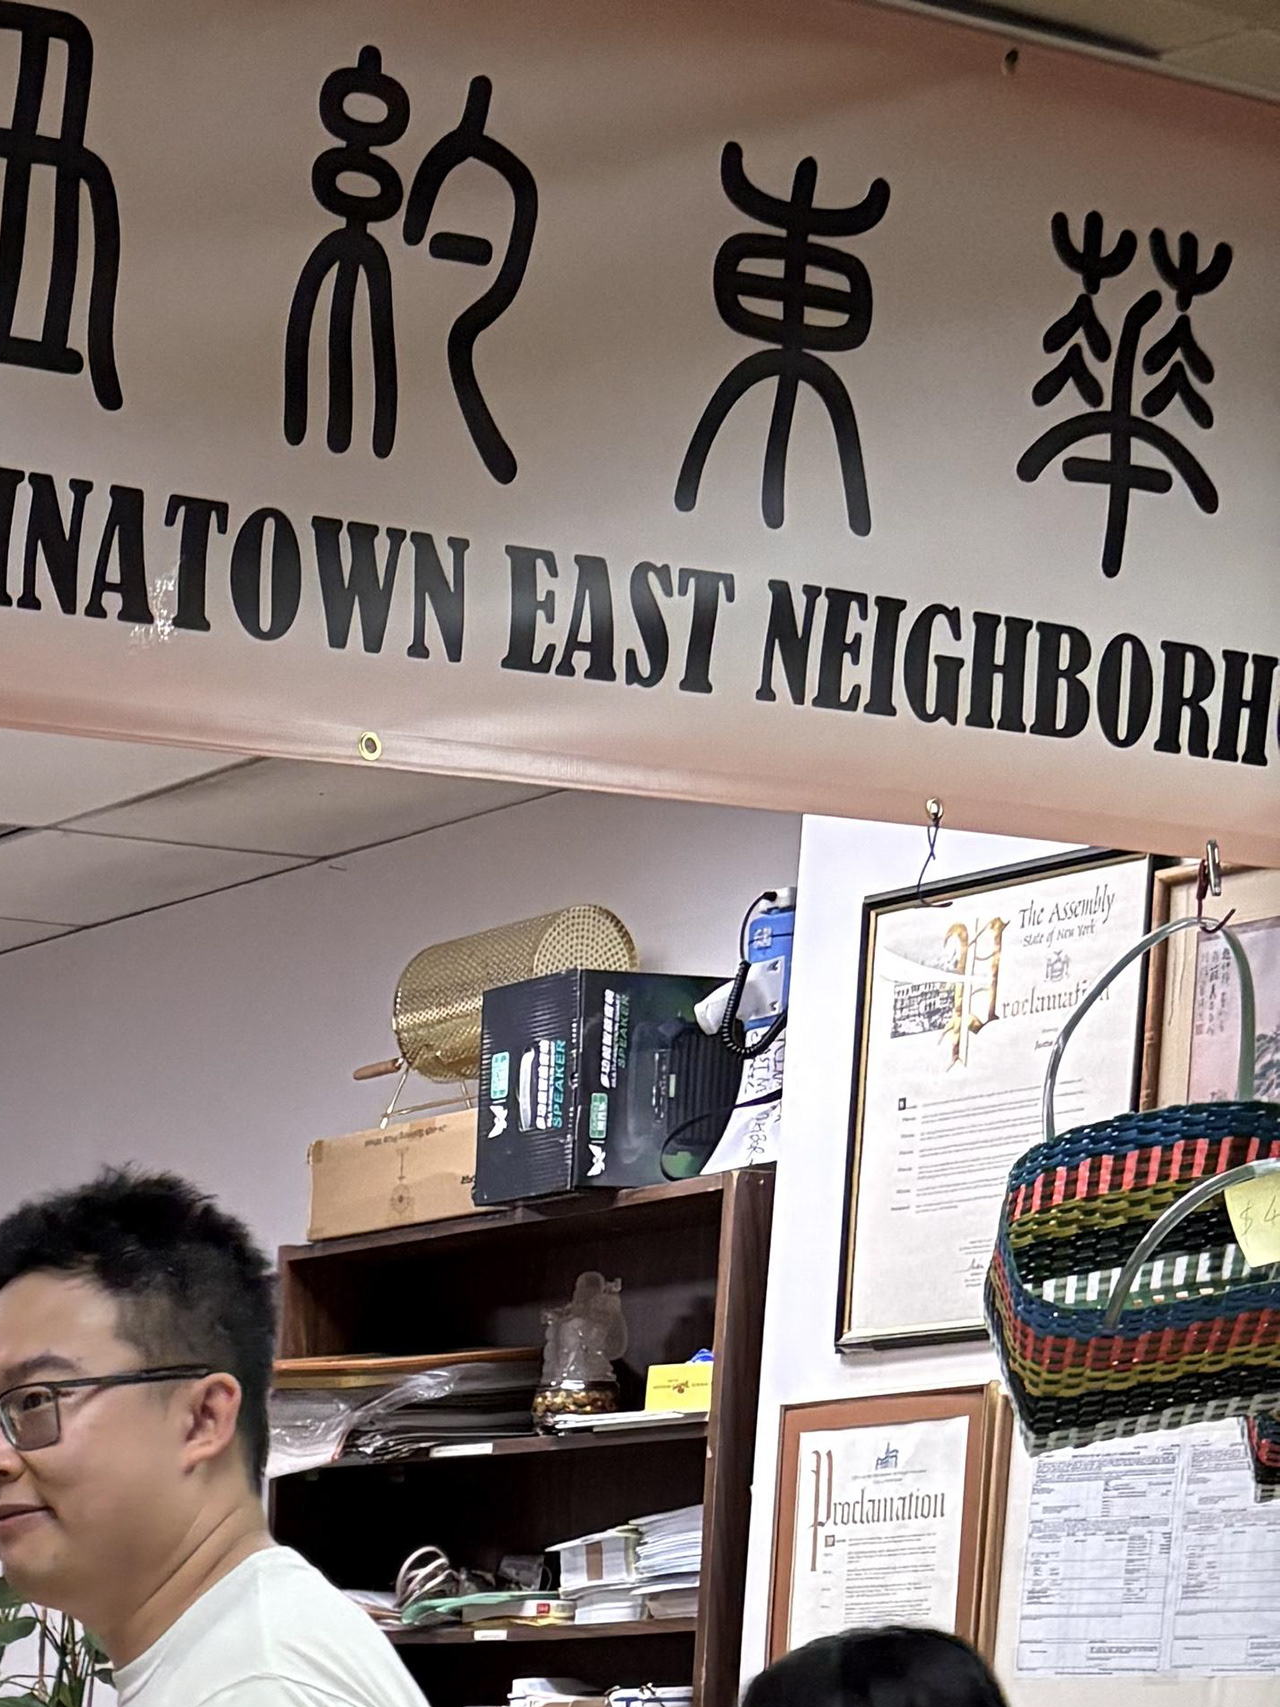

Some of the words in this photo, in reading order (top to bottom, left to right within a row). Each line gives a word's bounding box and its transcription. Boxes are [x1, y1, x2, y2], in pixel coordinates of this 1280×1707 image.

[502, 545, 735, 694] EAST
[756, 580, 1280, 768] NEIGHBORH
[1019, 899, 1043, 929] The
[1048, 882, 1116, 924] Assembly
[1023, 933, 1044, 947] State
[1076, 919, 1096, 938] York
[617, 992, 630, 1069] SPEAKER
[552, 1039, 567, 1130] SPEAKER
